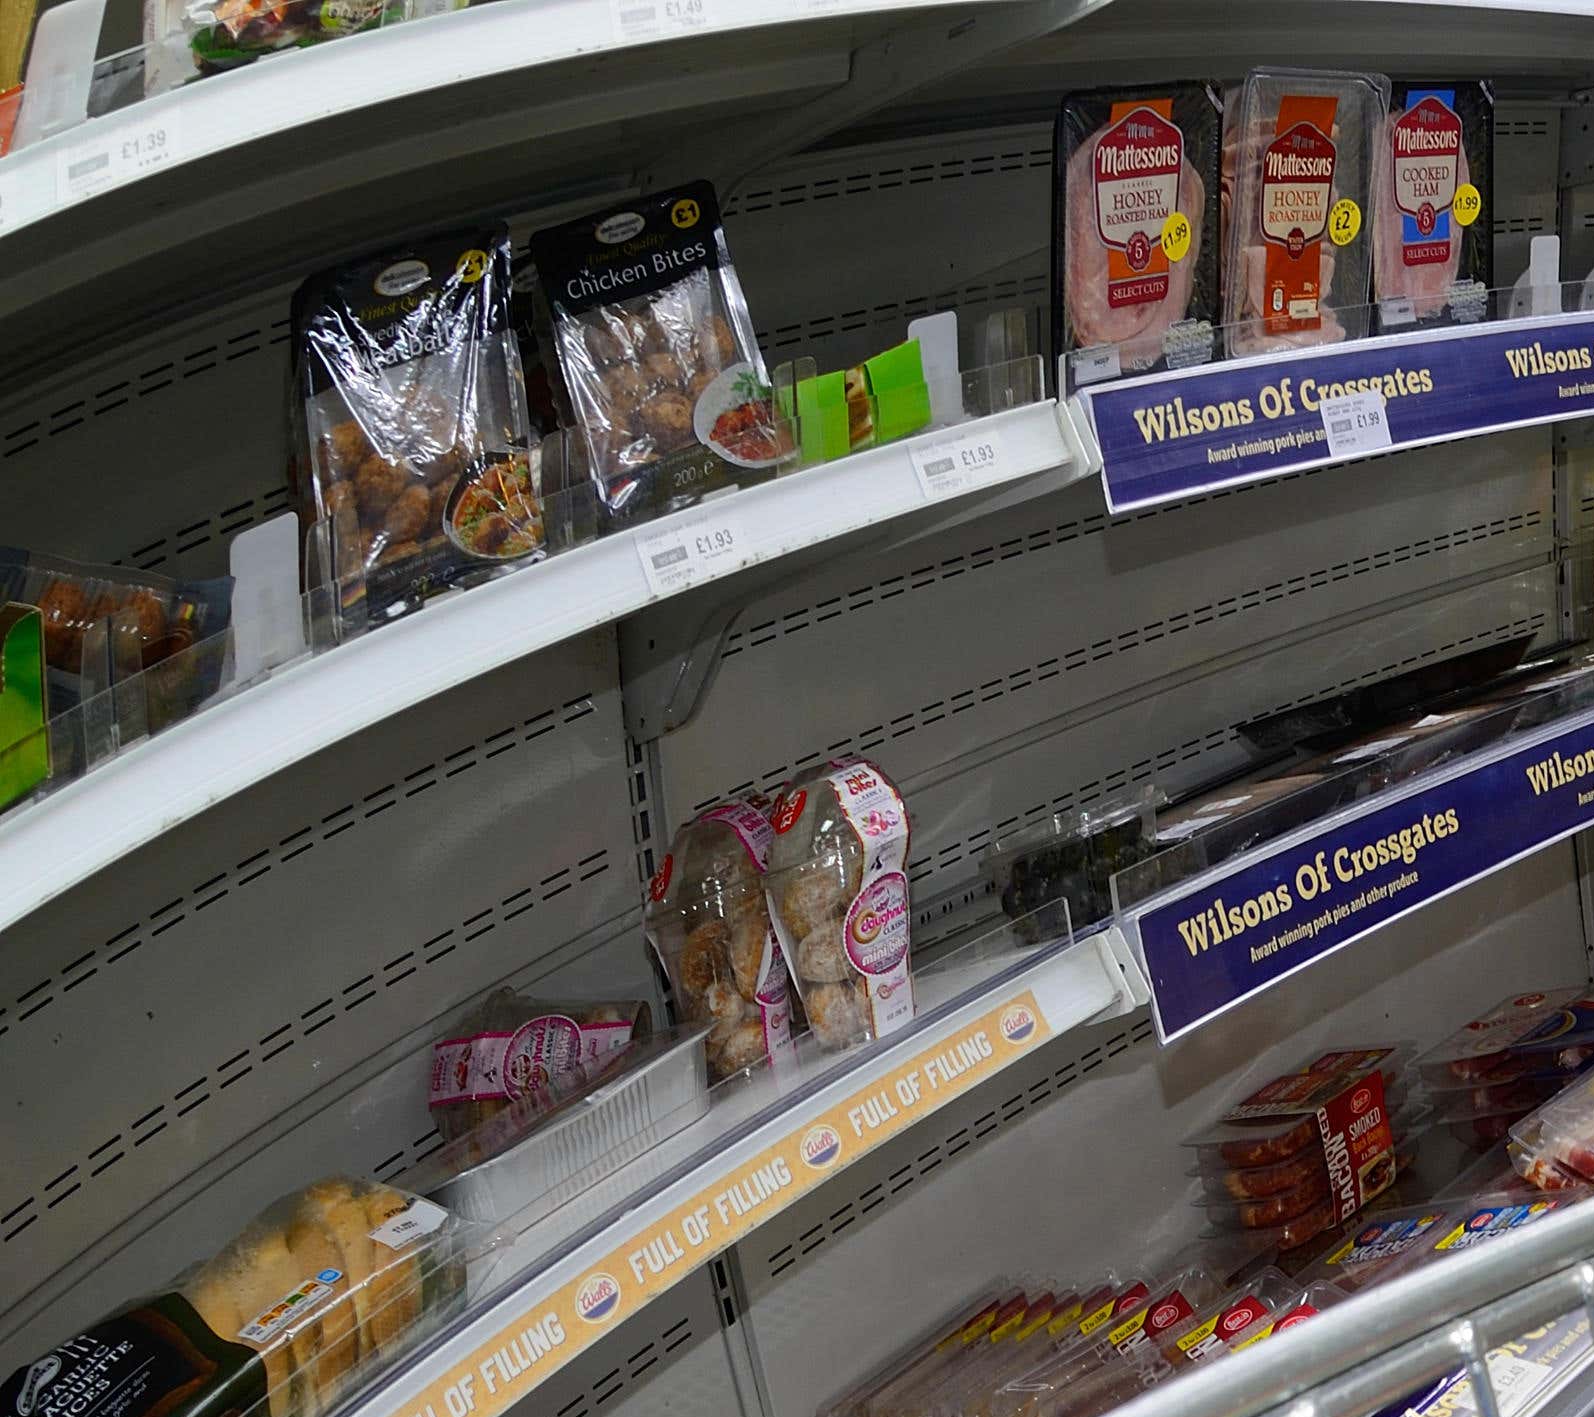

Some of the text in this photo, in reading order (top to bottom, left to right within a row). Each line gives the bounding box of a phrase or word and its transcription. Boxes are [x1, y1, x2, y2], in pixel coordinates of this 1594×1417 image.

[121, 130, 167, 160] £1.39
[1395, 126, 1458, 153] Mattessons
[1265, 151, 1332, 178] Mattessons
[1403, 167, 1449, 182] COOKED
[1113, 189, 1162, 211] HONEY
[1274, 191, 1320, 208] HONEY
[1413, 182, 1440, 197] HAM
[675, 205, 697, 224] £1
[567, 241, 707, 300] Chicken Bites
[696, 528, 734, 553] £1.93
[844, 771, 869, 788] mini
[1178, 806, 1460, 958] Wilsons Of Crossgates
[1249, 870, 1419, 965] Award winning pork pies and other produce
[1004, 1014, 1030, 1033] Wall's
[1349, 1107, 1382, 1141] SMOKED
[1333, 1131, 1356, 1220] BACON
[628, 1157, 793, 1285] FULL OF FILLING
